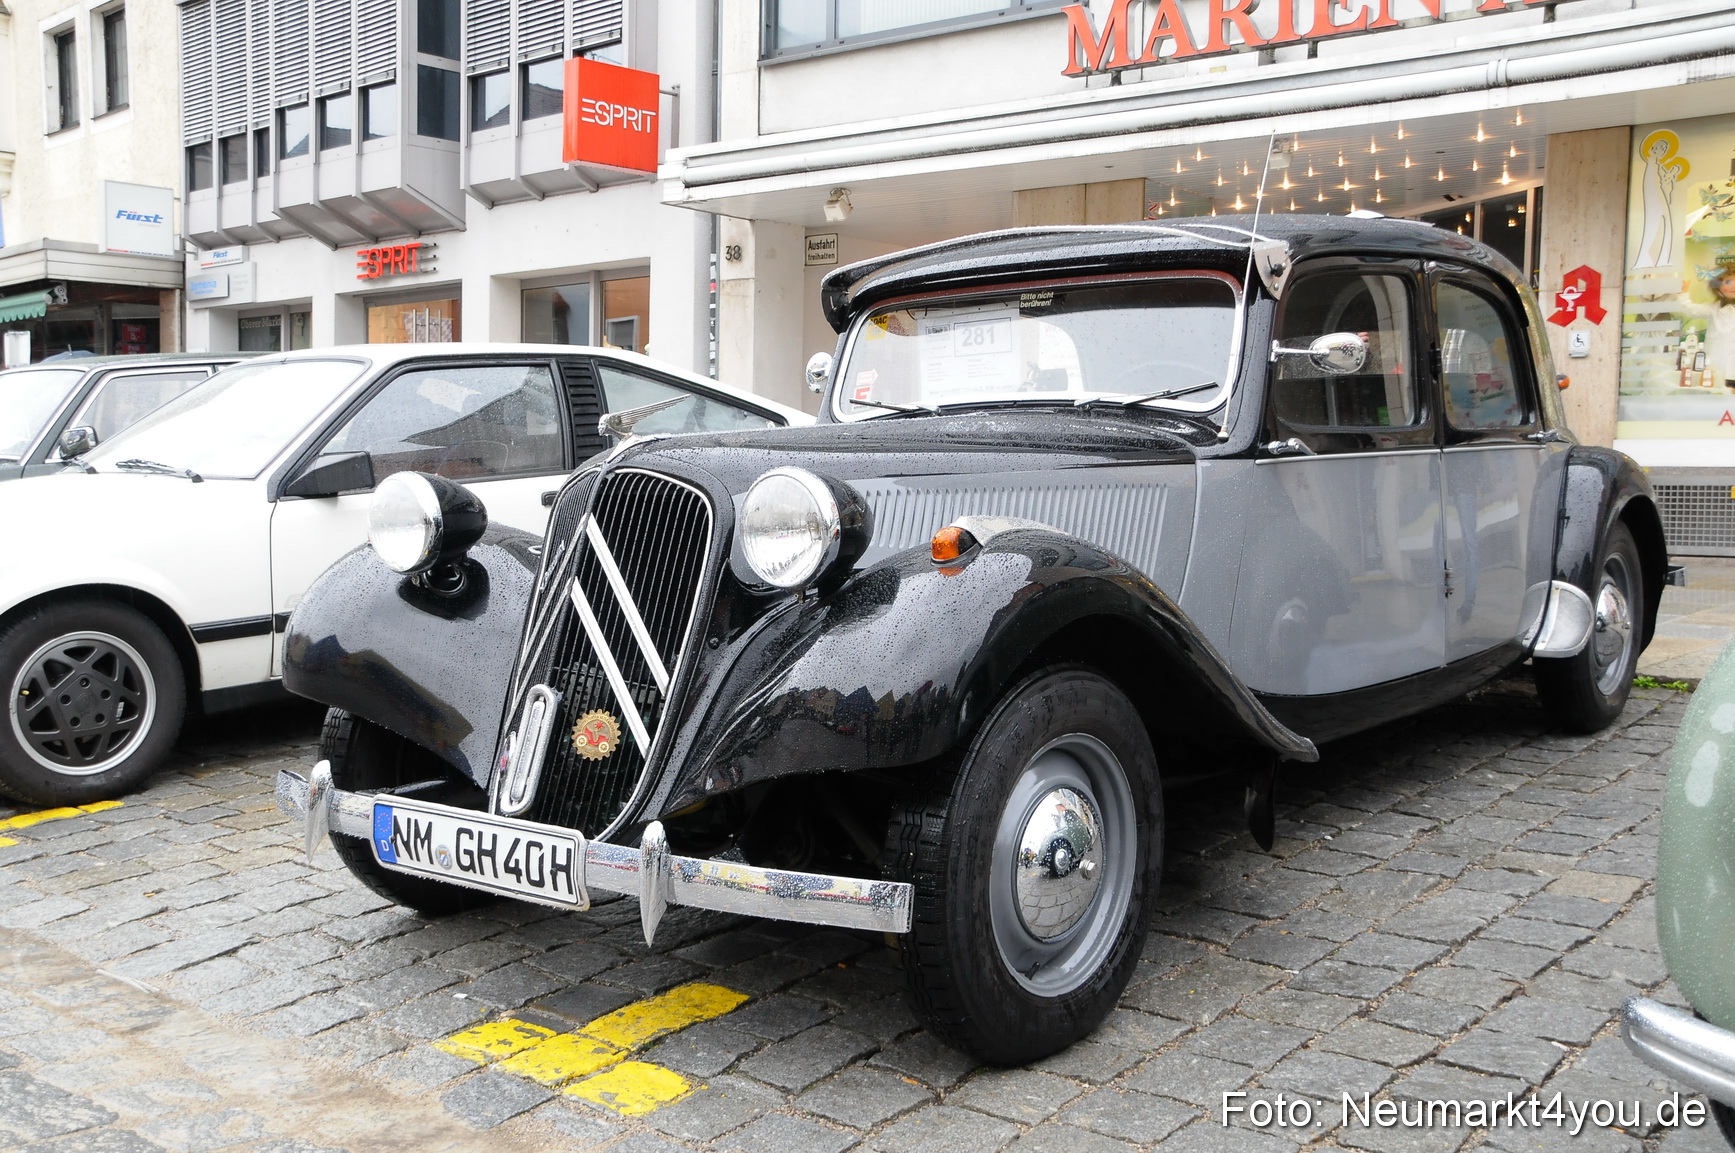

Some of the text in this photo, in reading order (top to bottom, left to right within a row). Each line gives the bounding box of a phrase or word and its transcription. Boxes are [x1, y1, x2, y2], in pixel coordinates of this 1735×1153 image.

[582, 98, 656, 133] ESPRIT
[116, 209, 164, 224] Fürst
[808, 239, 835, 250] Ausfahrt
[357, 242, 422, 279] ESPRIT
[725, 245, 742, 261] 38
[808, 252, 835, 260] freihalten
[1020, 299, 1052, 308] berühren!
[962, 325, 995, 347] 281
[381, 840, 389, 852] D
[393, 815, 434, 865] NM
